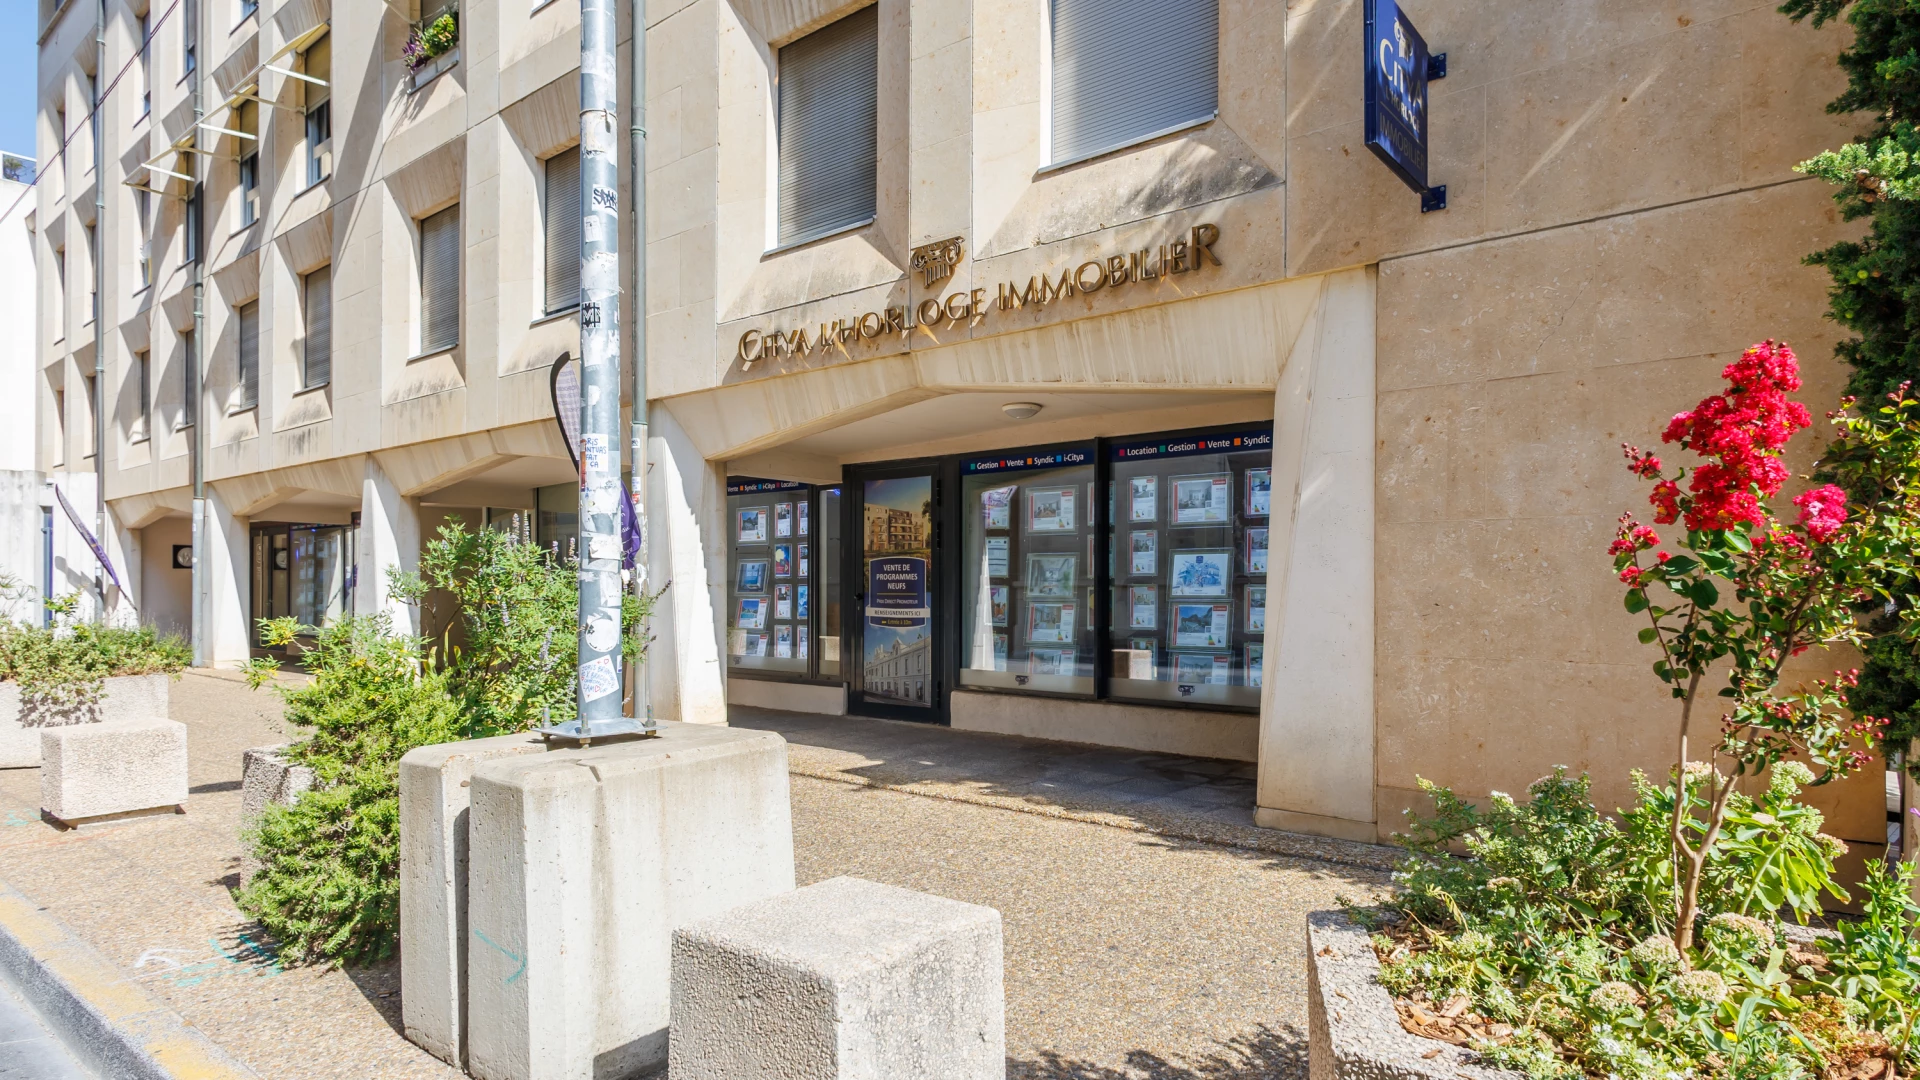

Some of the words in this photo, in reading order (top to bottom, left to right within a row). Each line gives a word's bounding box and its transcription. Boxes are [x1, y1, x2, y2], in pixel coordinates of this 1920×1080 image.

[1379, 112, 1425, 171] IMMOBILIER
[820, 287, 986, 347] L'HORLOGE
[996, 222, 1223, 311] IMMOBILIER
[1127, 446, 1157, 456] Location
[1168, 443, 1196, 452] Gestion
[1207, 439, 1230, 448] Vente
[1243, 435, 1270, 446] Syndic
[976, 461, 999, 470] Gestion
[1006, 458, 1024, 467] Vente
[1034, 455, 1054, 465] Syndic
[1063, 453, 1084, 463] i-Citya
[887, 582, 906, 590] NEUFS
